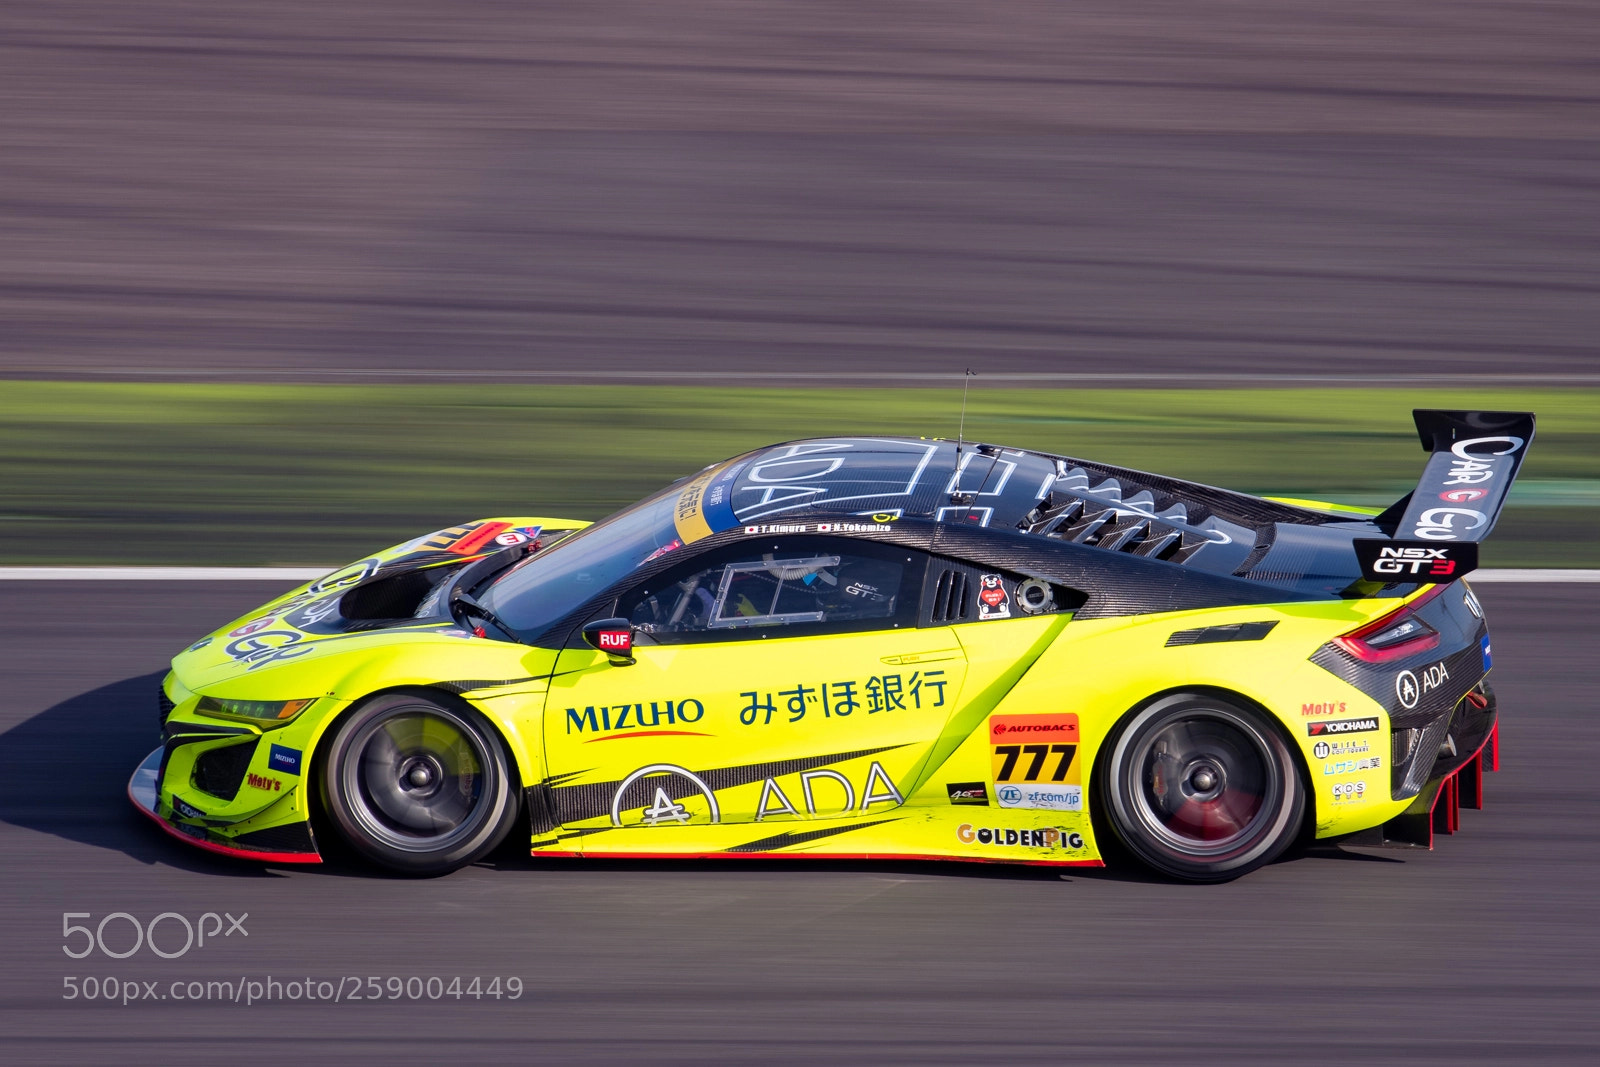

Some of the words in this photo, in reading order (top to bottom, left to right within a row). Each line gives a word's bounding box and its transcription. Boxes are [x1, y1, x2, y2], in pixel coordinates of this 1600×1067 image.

[761, 525, 806, 534] T.Kimura
[833, 523, 891, 532] N.Yokomizo
[1414, 507, 1488, 540] GU
[1380, 547, 1449, 559] NSX
[1373, 558, 1456, 575] GT3
[854, 582, 879, 592] NSX
[600, 633, 629, 647] RUF
[1423, 661, 1450, 694] ADA
[739, 670, 948, 726] みずほ銀行
[1301, 701, 1347, 716] Moty's
[566, 698, 705, 735] MIZUHO
[1007, 724, 1076, 733] AUTOBACS
[1325, 720, 1377, 733] YOKOHAMA
[994, 744, 1077, 782] 777
[754, 760, 905, 821] ADA
[1028, 792, 1079, 805] zf.com/jp
